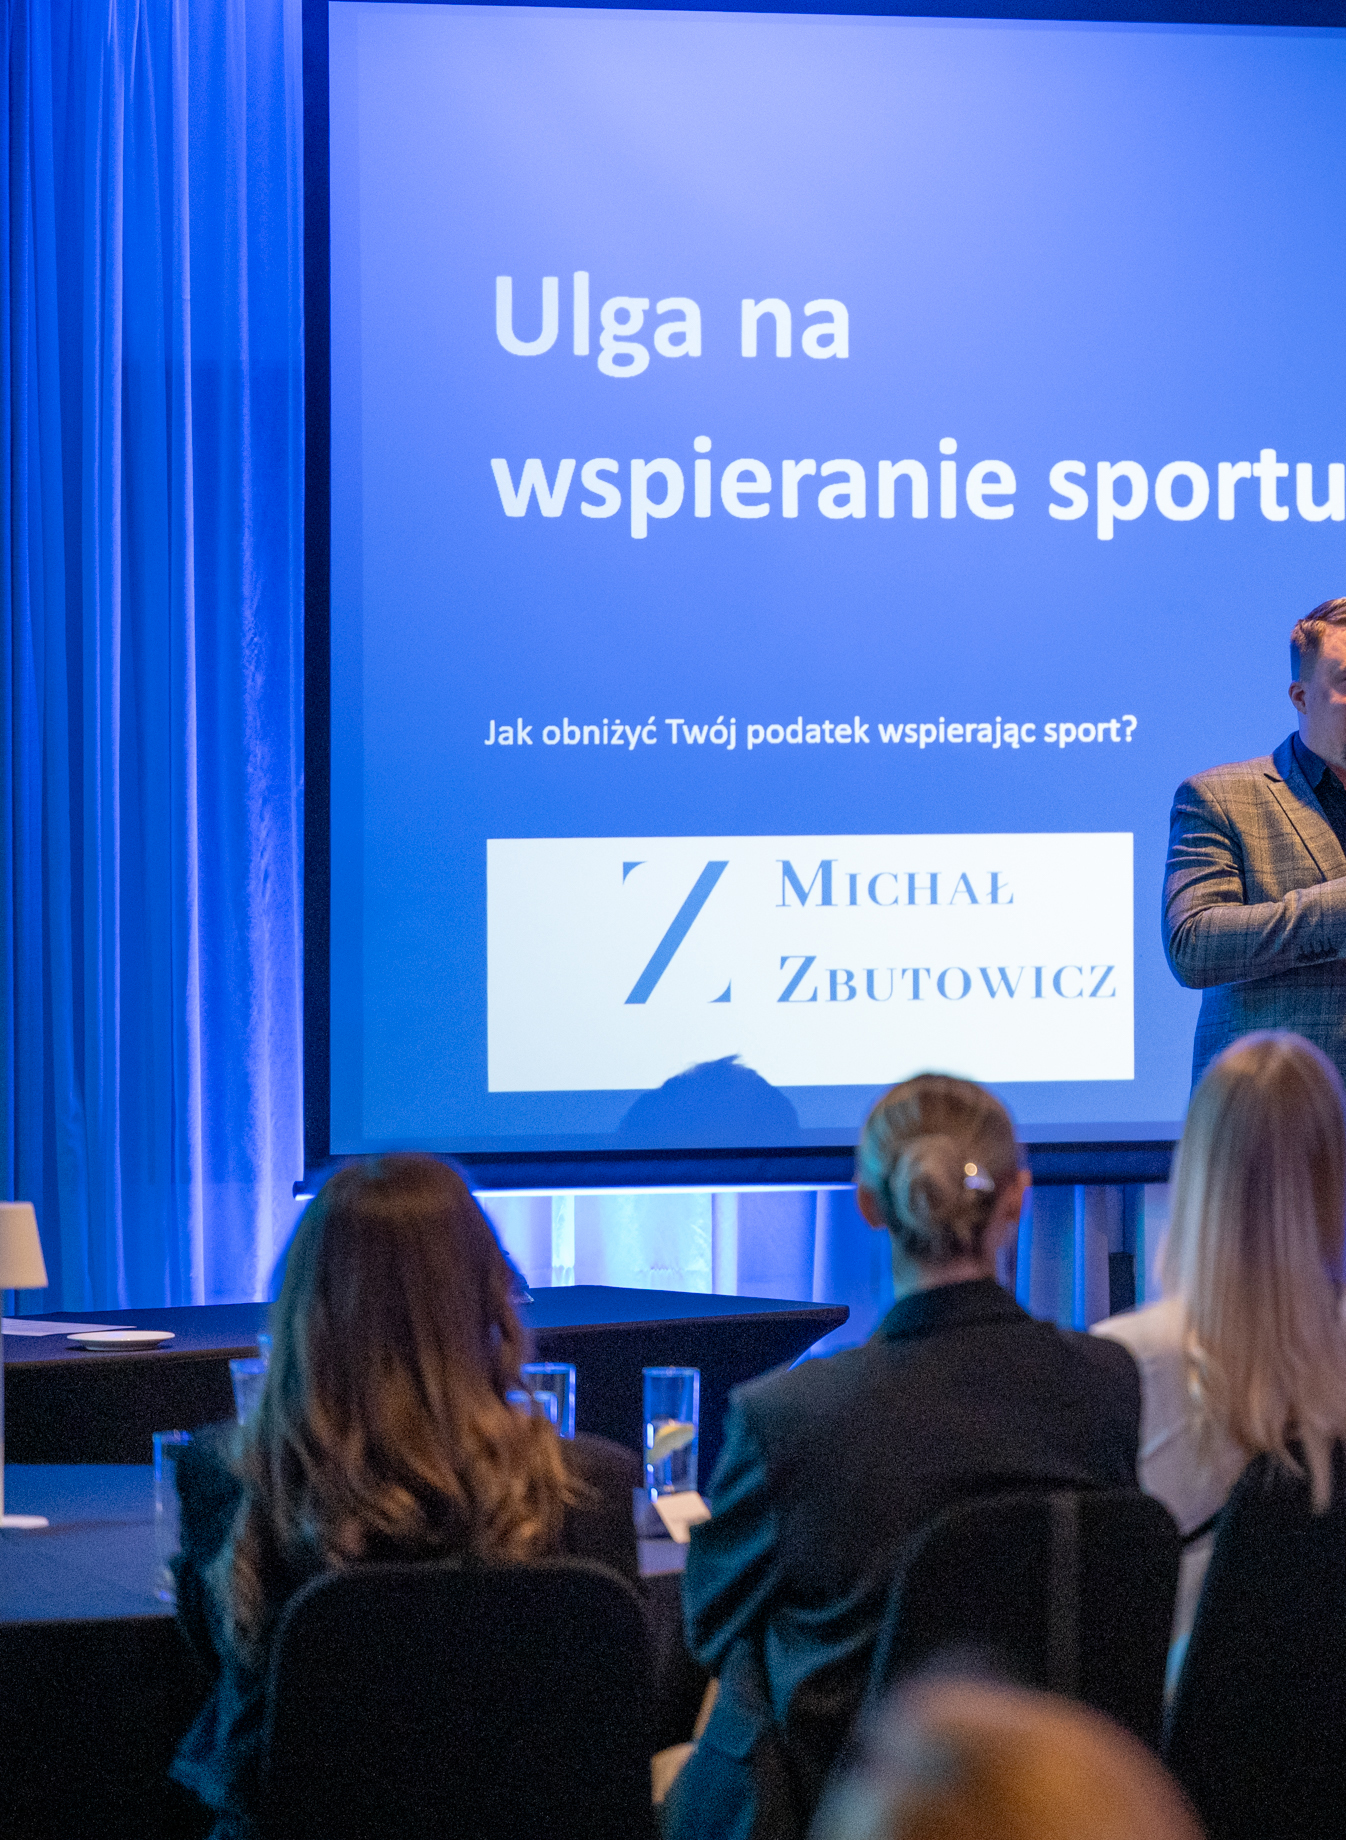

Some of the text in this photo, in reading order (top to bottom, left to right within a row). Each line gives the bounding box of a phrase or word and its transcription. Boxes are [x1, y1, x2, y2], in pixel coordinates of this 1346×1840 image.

[494, 270, 850, 379] Ulga na
[490, 435, 1346, 541] wspieranie sportu
[484, 714, 1138, 750] Jak obniżyć Twój podatek wspierając sport?
